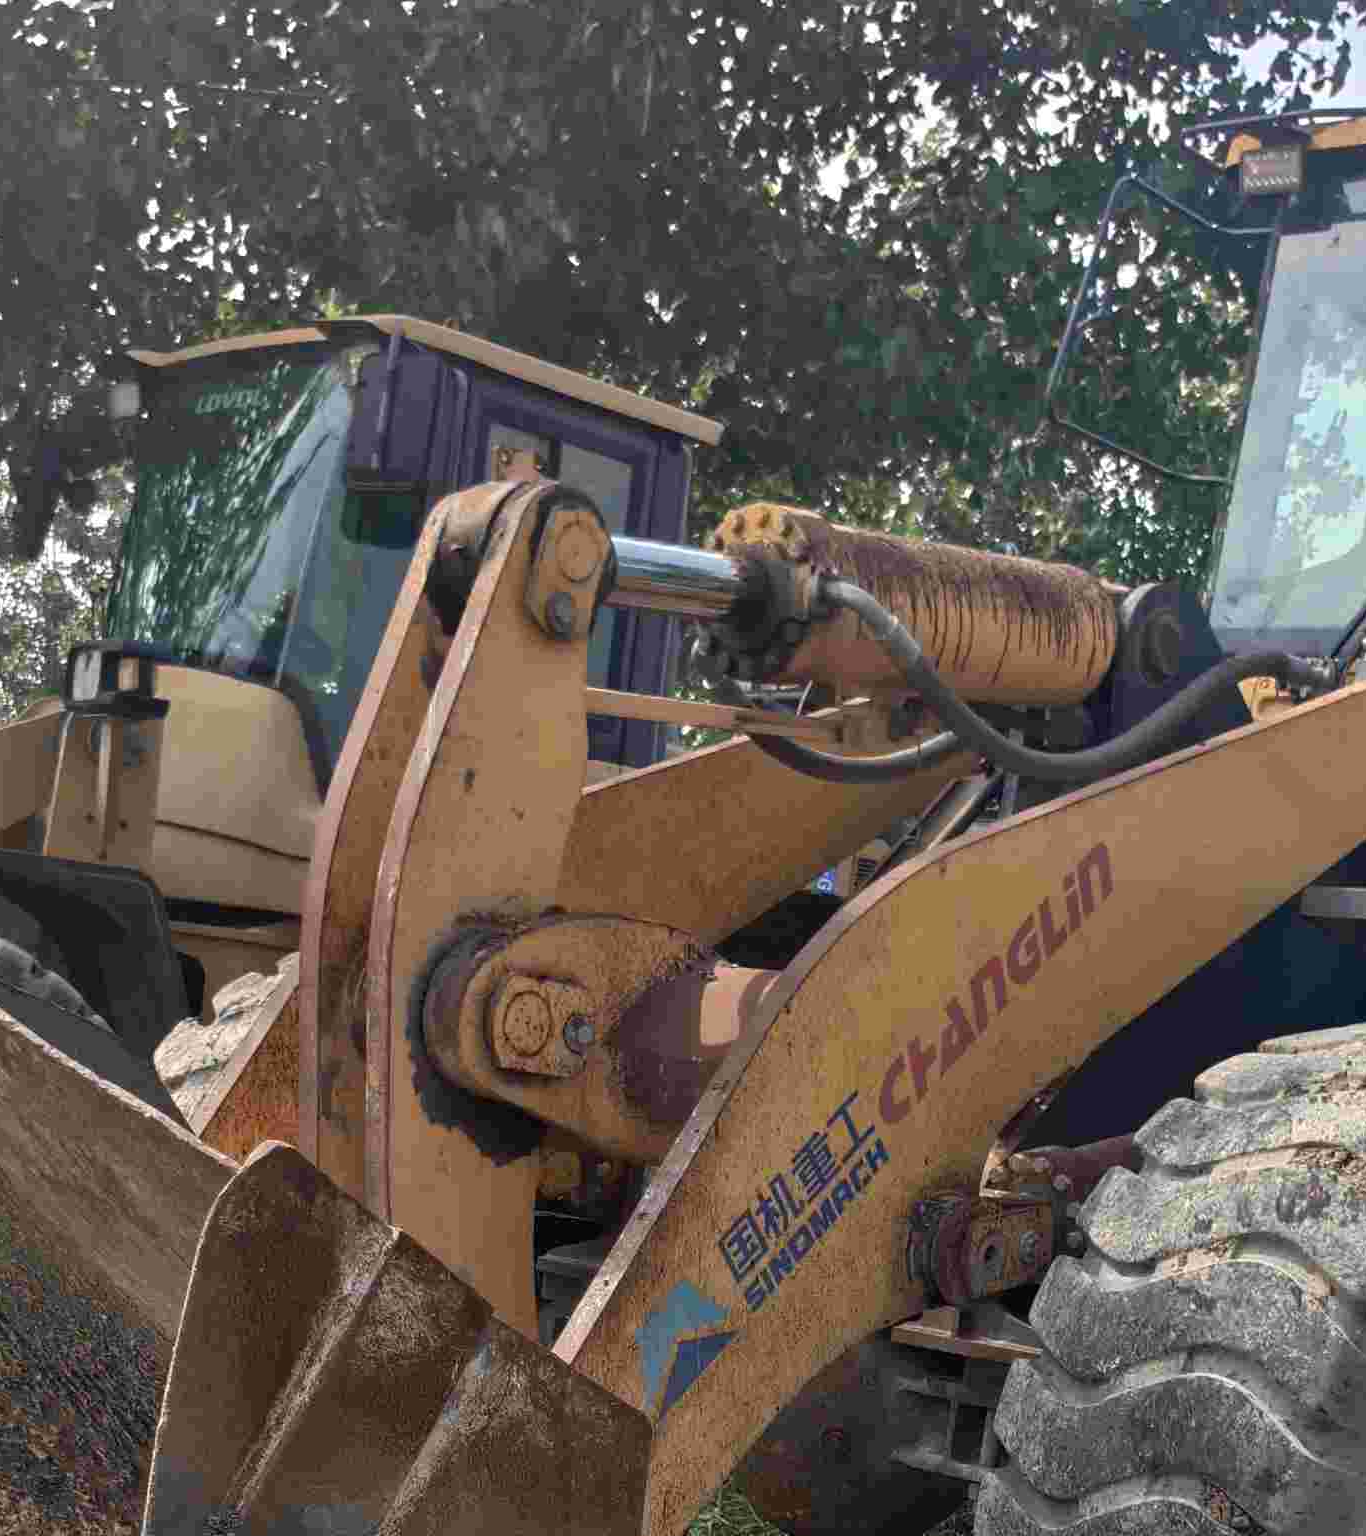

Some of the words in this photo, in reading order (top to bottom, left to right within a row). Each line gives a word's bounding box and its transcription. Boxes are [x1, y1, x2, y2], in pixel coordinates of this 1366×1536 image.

[718, 1091, 876, 1282] 国机重工
[746, 1137, 891, 1312] SINOMACH
